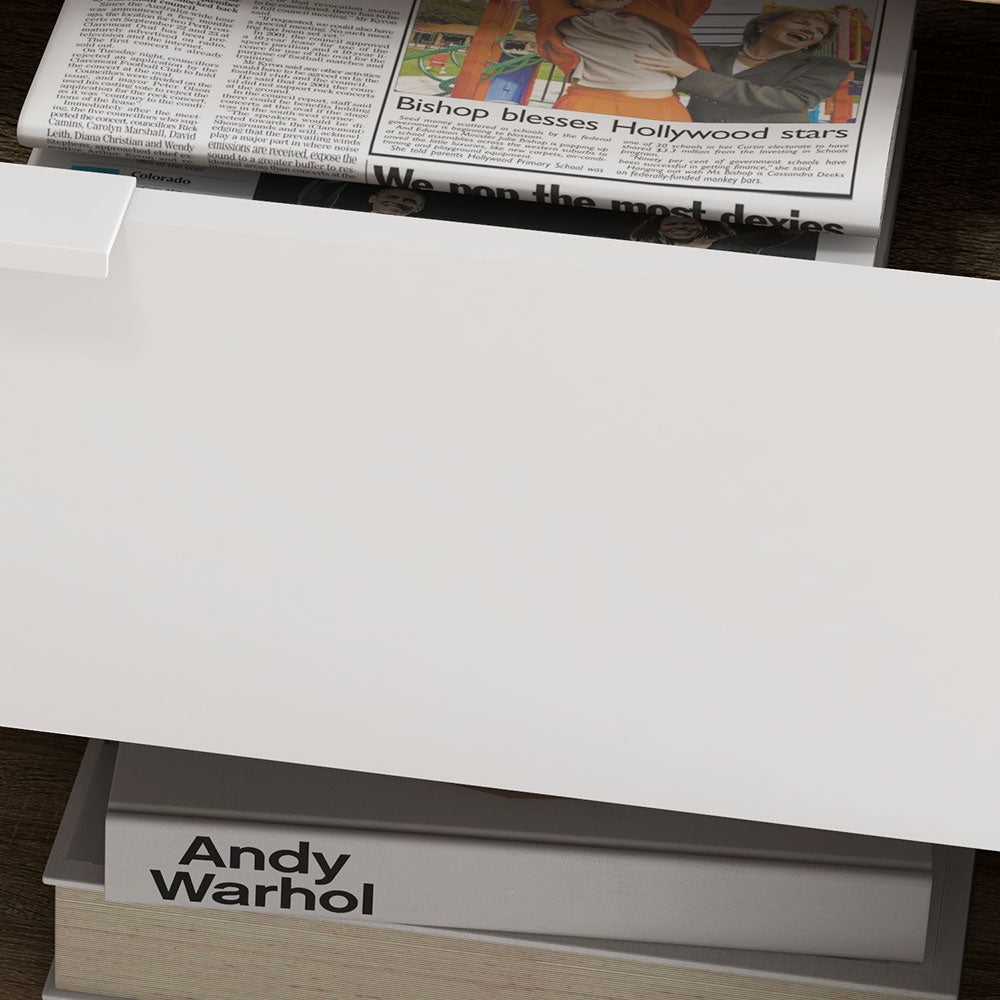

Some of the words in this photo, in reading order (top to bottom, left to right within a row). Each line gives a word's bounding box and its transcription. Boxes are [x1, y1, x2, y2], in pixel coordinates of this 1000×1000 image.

[48, 117, 84, 130] Camins,
[86, 121, 124, 134] Carolyn
[125, 125, 168, 139] Marshall,
[169, 129, 198, 141] David
[396, 96, 489, 121] Bishop
[502, 107, 600, 131] blesses
[611, 119, 770, 143] Hollywood
[781, 127, 849, 140] stars
[46, 128, 73, 140] Leith,
[74, 130, 102, 142] Diana
[102, 134, 144, 147] Christian
[144, 139, 163, 148] and
[164, 141, 196, 154] Wendy
[131, 170, 192, 186] Colorado
[373, 164, 434, 190] We
[531, 184, 597, 207] the
[611, 200, 706, 221] most
[616, 169, 629, 177] on
[630, 169, 702, 183] federally-funded
[703, 176, 739, 186] monkey
[177, 835, 351, 886] Andy
[149, 868, 374, 916] Warhol
